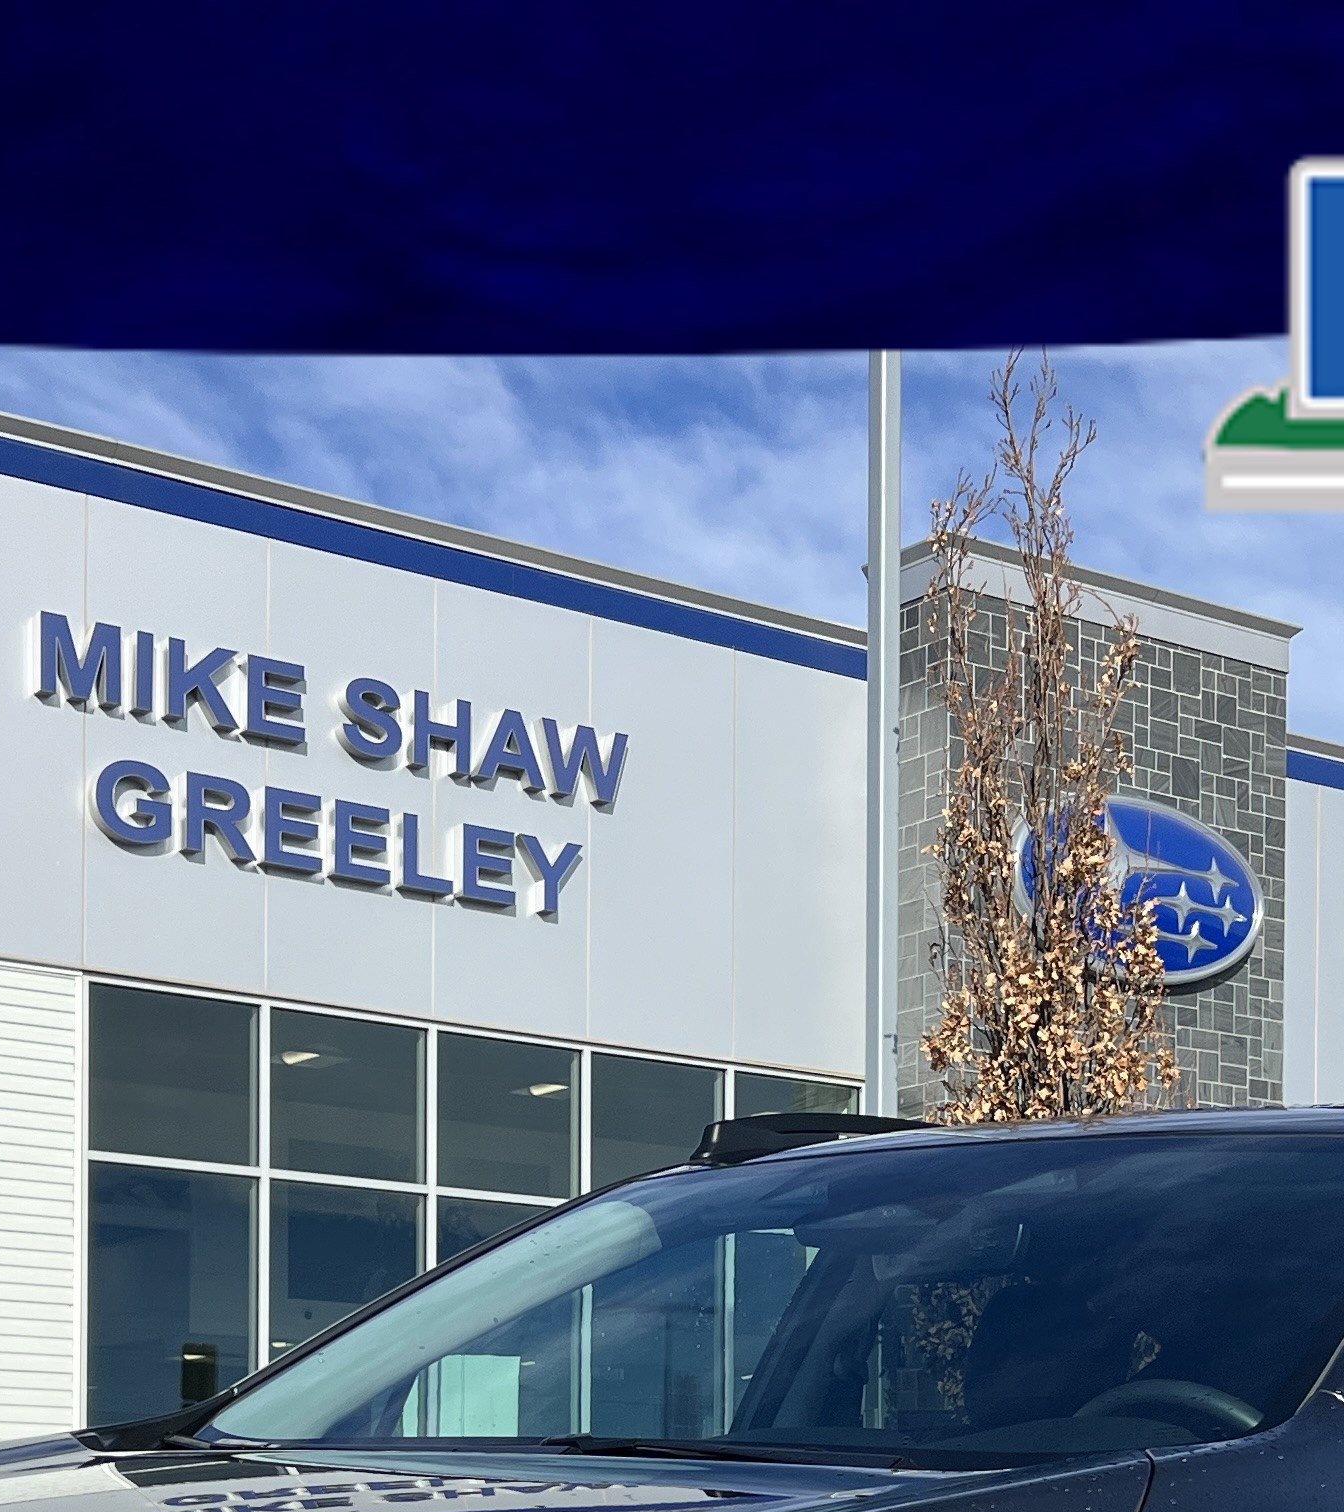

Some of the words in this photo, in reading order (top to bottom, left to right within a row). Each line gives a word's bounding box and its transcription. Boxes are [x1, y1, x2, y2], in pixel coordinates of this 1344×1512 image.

[35, 609, 306, 746] MIKE
[338, 676, 631, 806] SHAW
[90, 758, 584, 917] GREELEY
